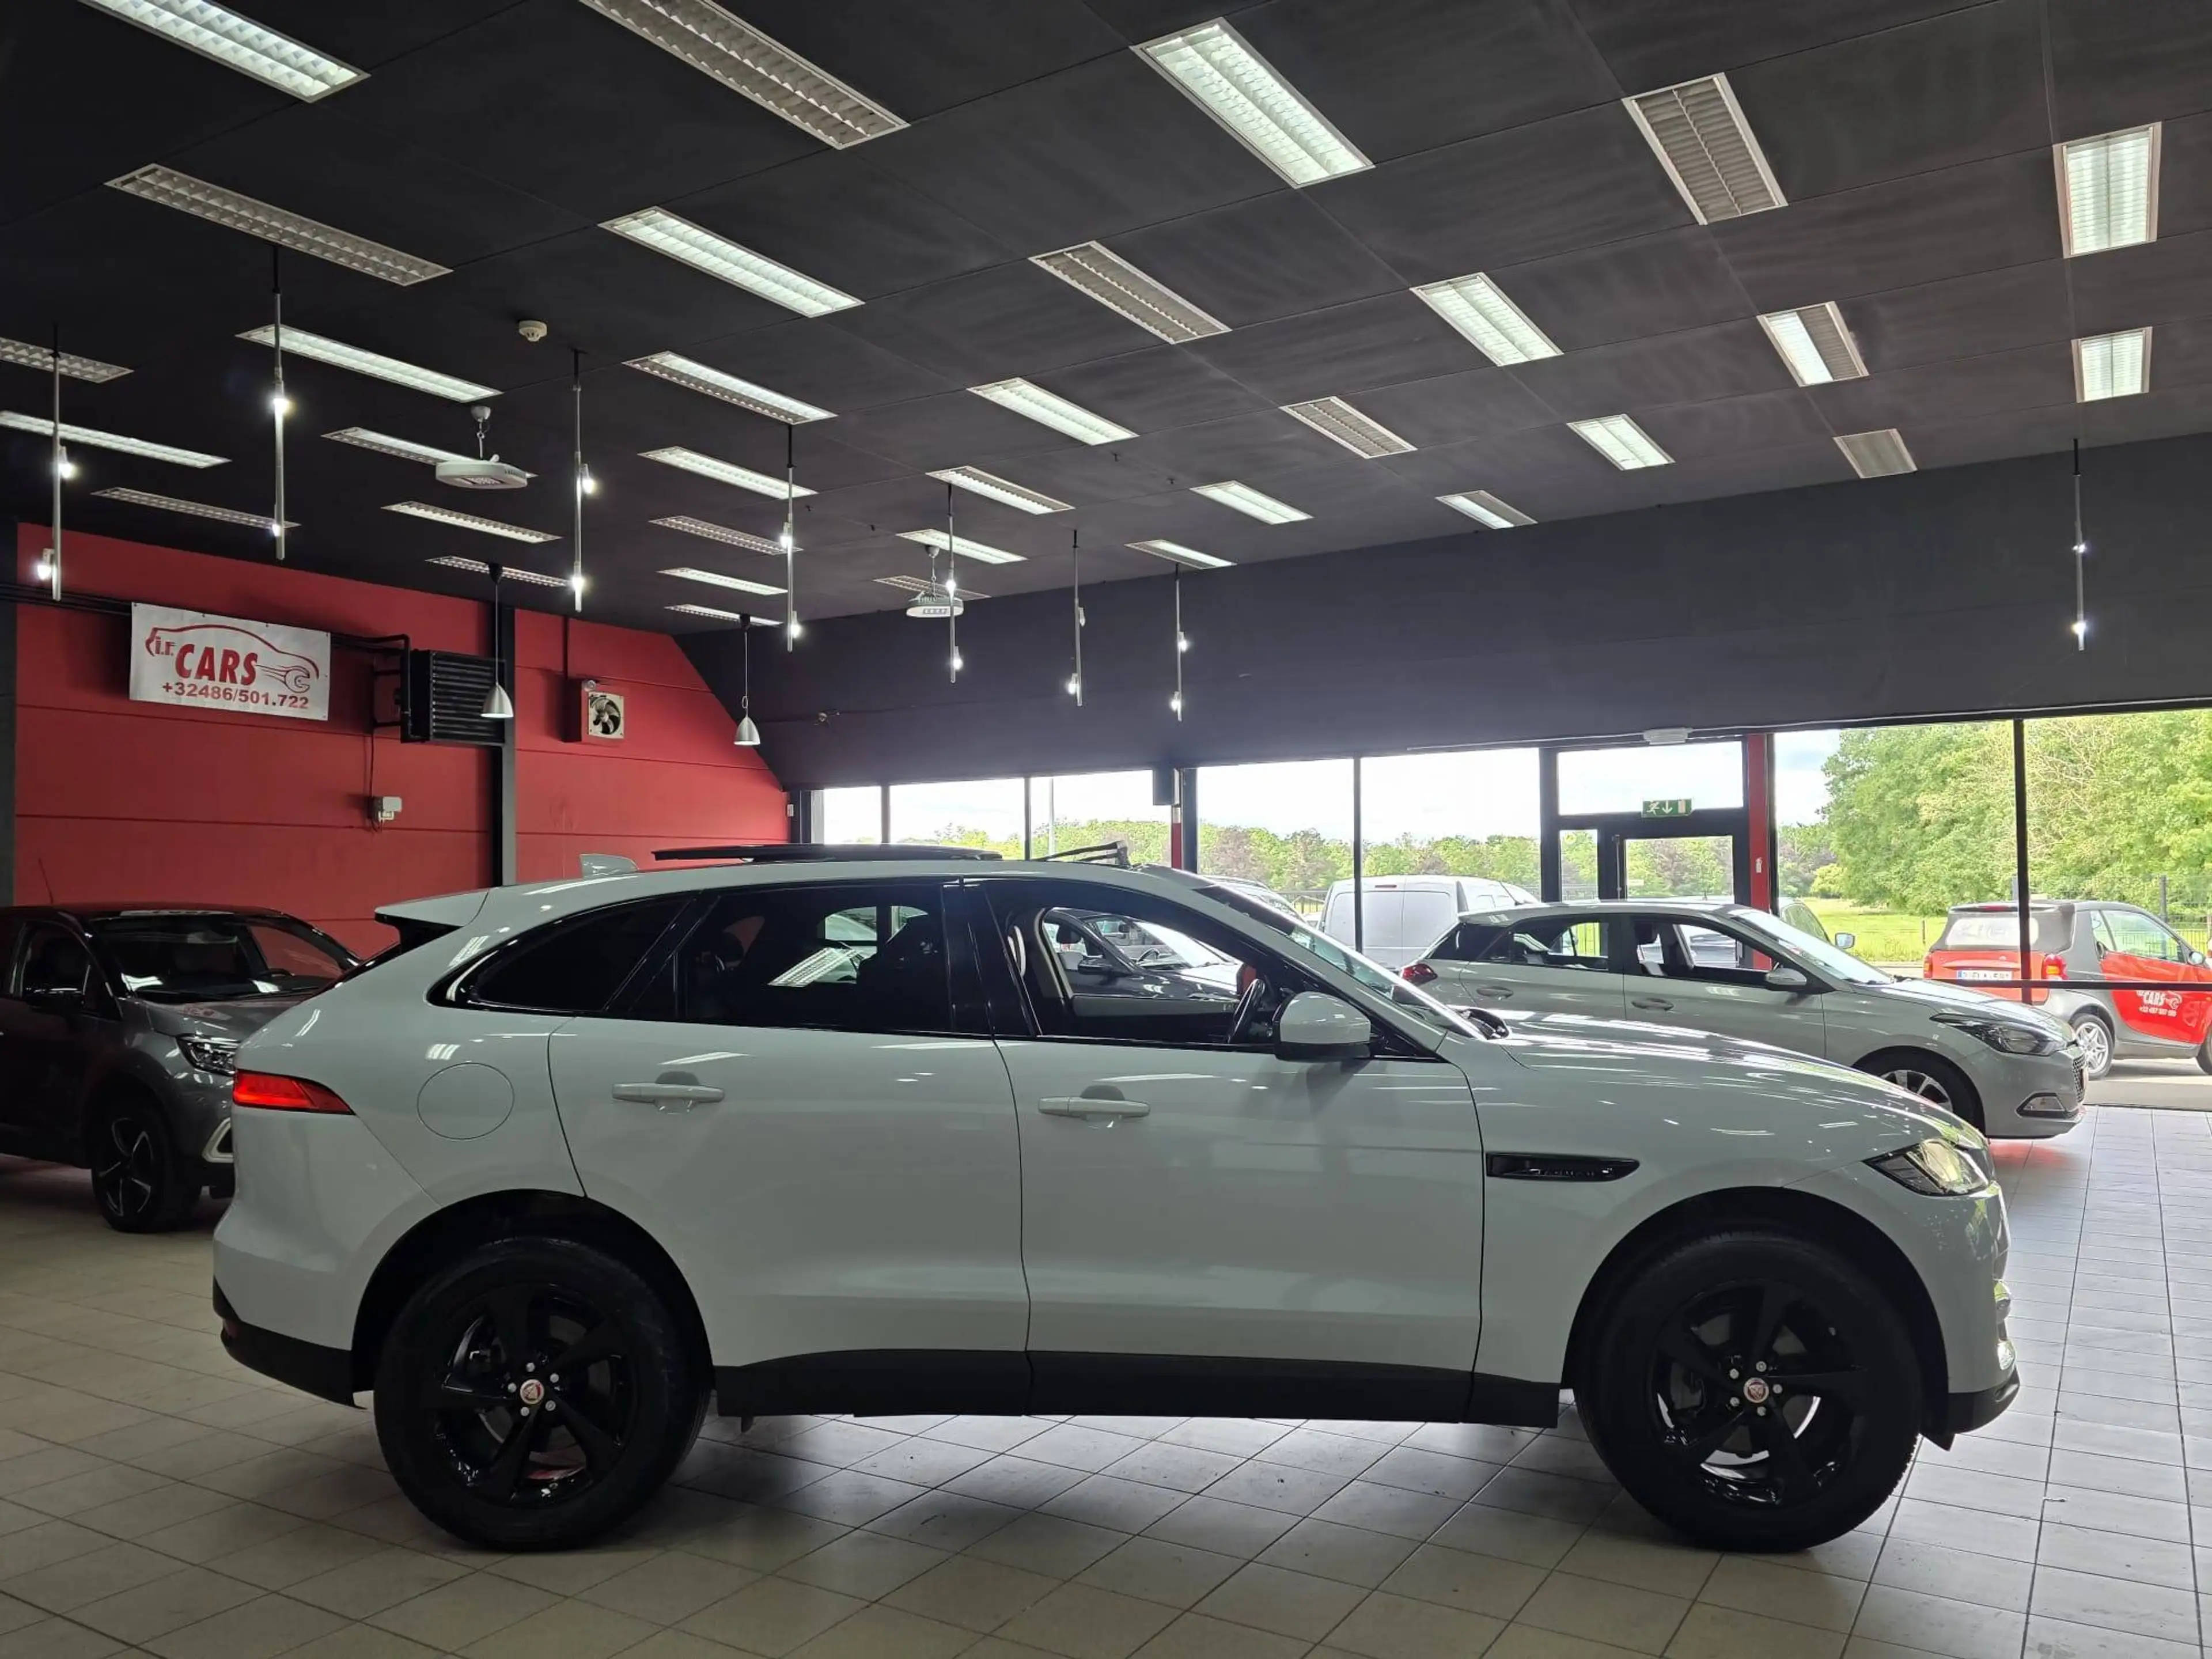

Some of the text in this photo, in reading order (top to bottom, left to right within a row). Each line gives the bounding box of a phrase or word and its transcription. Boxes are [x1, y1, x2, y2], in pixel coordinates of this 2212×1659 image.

[175, 643, 257, 685] CARS
[162, 682, 309, 709] +32486/501.722
[2143, 991, 2165, 1006] CARS
